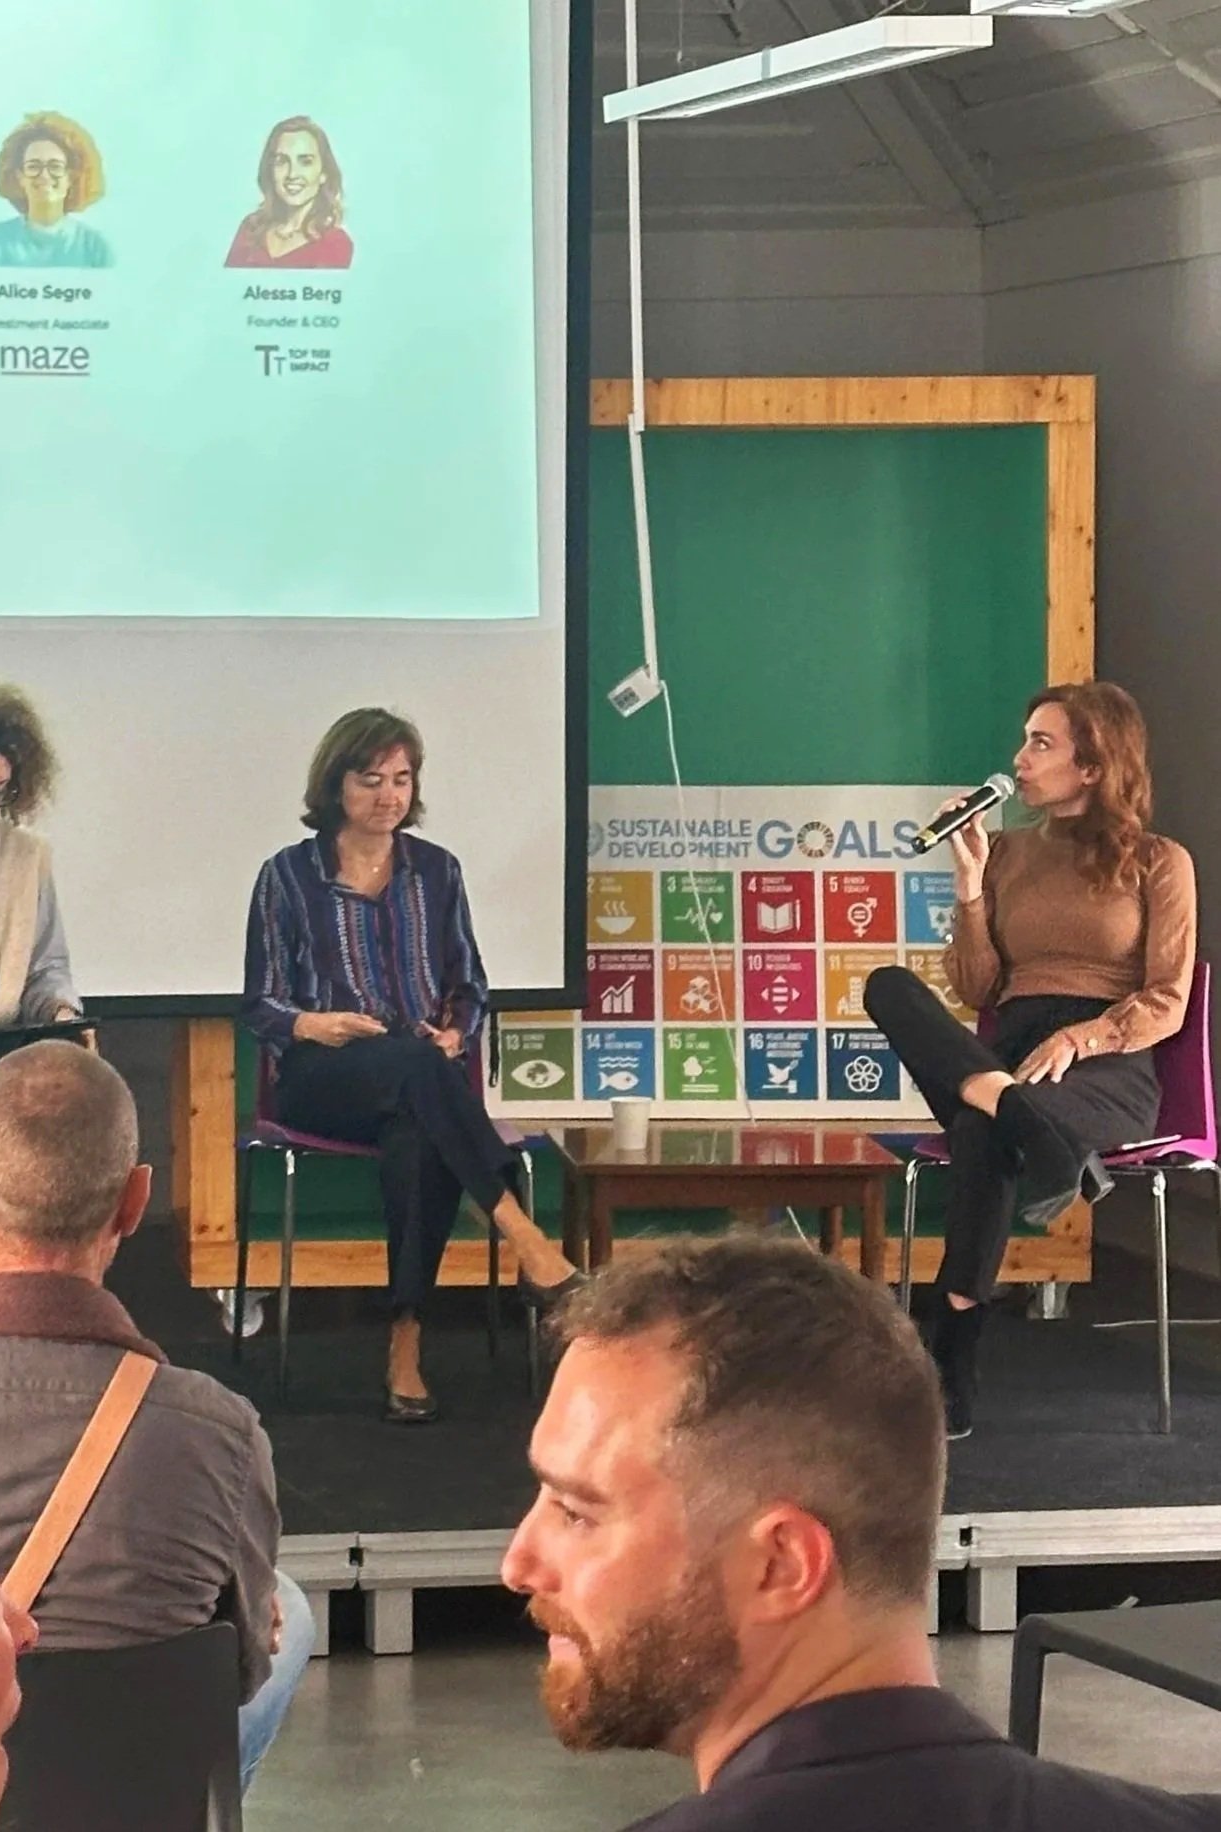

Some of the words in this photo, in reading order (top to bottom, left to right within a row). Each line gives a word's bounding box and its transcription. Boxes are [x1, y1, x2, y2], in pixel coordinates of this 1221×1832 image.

[42, 284, 92, 302] Segre
[243, 285, 297, 300] Alessa
[302, 286, 342, 304] Berg
[0, 345, 90, 370] maze
[607, 819, 753, 838] SUSTAINABLE
[608, 841, 753, 859] DEVELOPMENT
[666, 875, 677, 893] 3
[747, 876, 758, 893] 4
[828, 876, 839, 893] 5
[909, 877, 920, 893] 6
[586, 953, 596, 971] 8
[667, 954, 677, 971] 9
[747, 954, 763, 971] 10
[828, 955, 841, 971] 11
[910, 955, 925, 971] 12
[505, 1034, 520, 1050] 13
[586, 1033, 601, 1050] 14
[668, 1034, 682, 1050] 15
[748, 1033, 764, 1050] 16
[832, 1033, 845, 1050] 17
